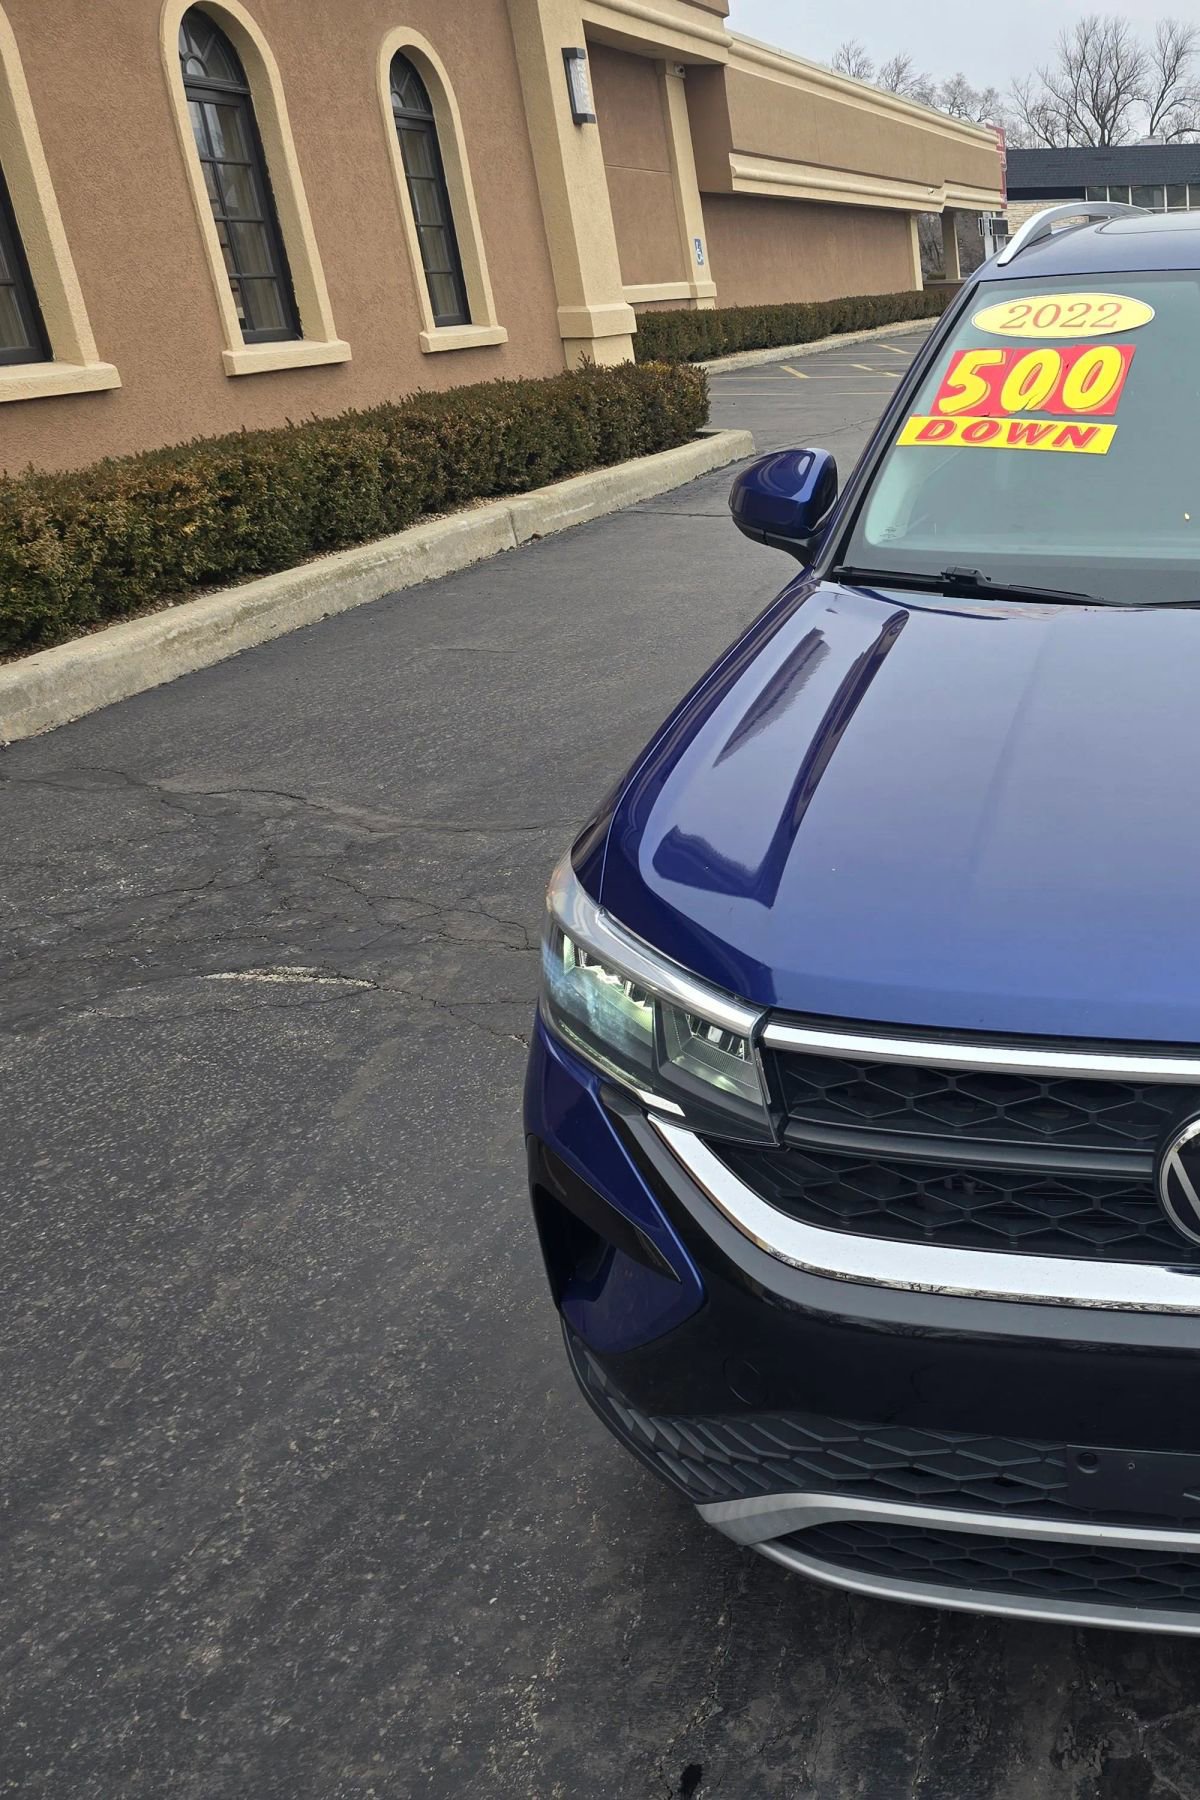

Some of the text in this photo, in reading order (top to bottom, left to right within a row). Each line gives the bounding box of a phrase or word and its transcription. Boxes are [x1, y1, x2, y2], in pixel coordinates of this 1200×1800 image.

[1000, 302, 1123, 329] 2022
[938, 345, 1126, 414] 500
[915, 419, 1101, 448] DOWN
